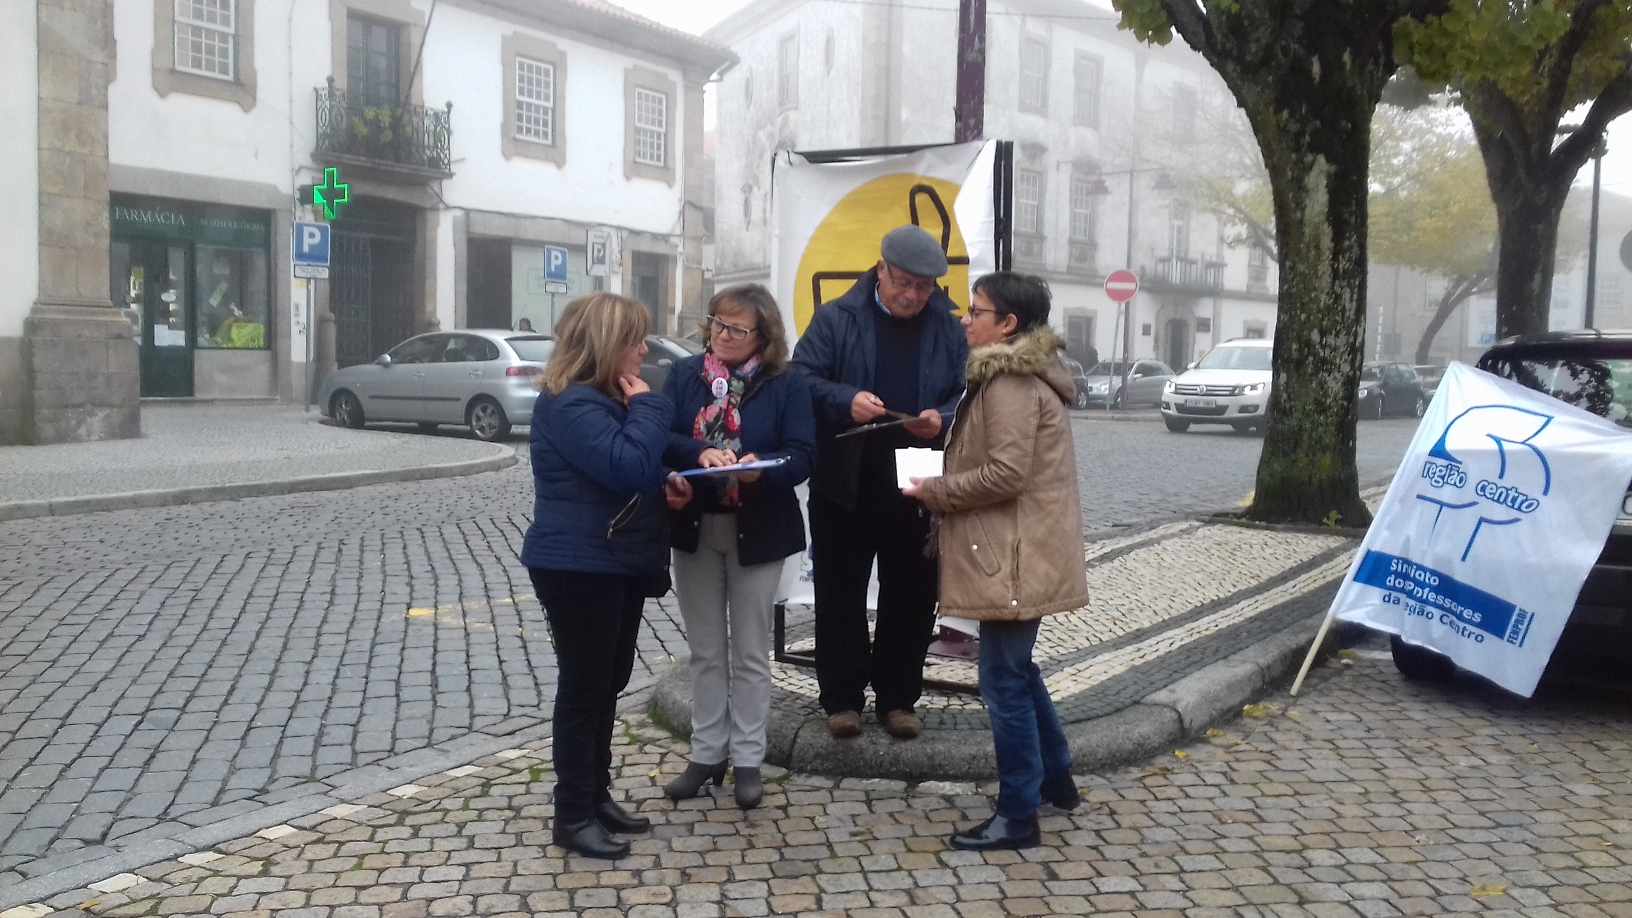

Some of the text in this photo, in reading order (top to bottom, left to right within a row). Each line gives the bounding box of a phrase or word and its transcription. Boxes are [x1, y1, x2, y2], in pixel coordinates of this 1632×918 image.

[115, 206, 186, 226] FARMÁCIA
[302, 225, 321, 253] P
[593, 243, 604, 263] P
[550, 249, 563, 272] P
[1421, 460, 1540, 513] região centro
[1390, 558, 1440, 586] Siniato
[1405, 580, 1483, 624] Pofessores
[1382, 592, 1401, 605] da
[1439, 613, 1485, 644] Centro
